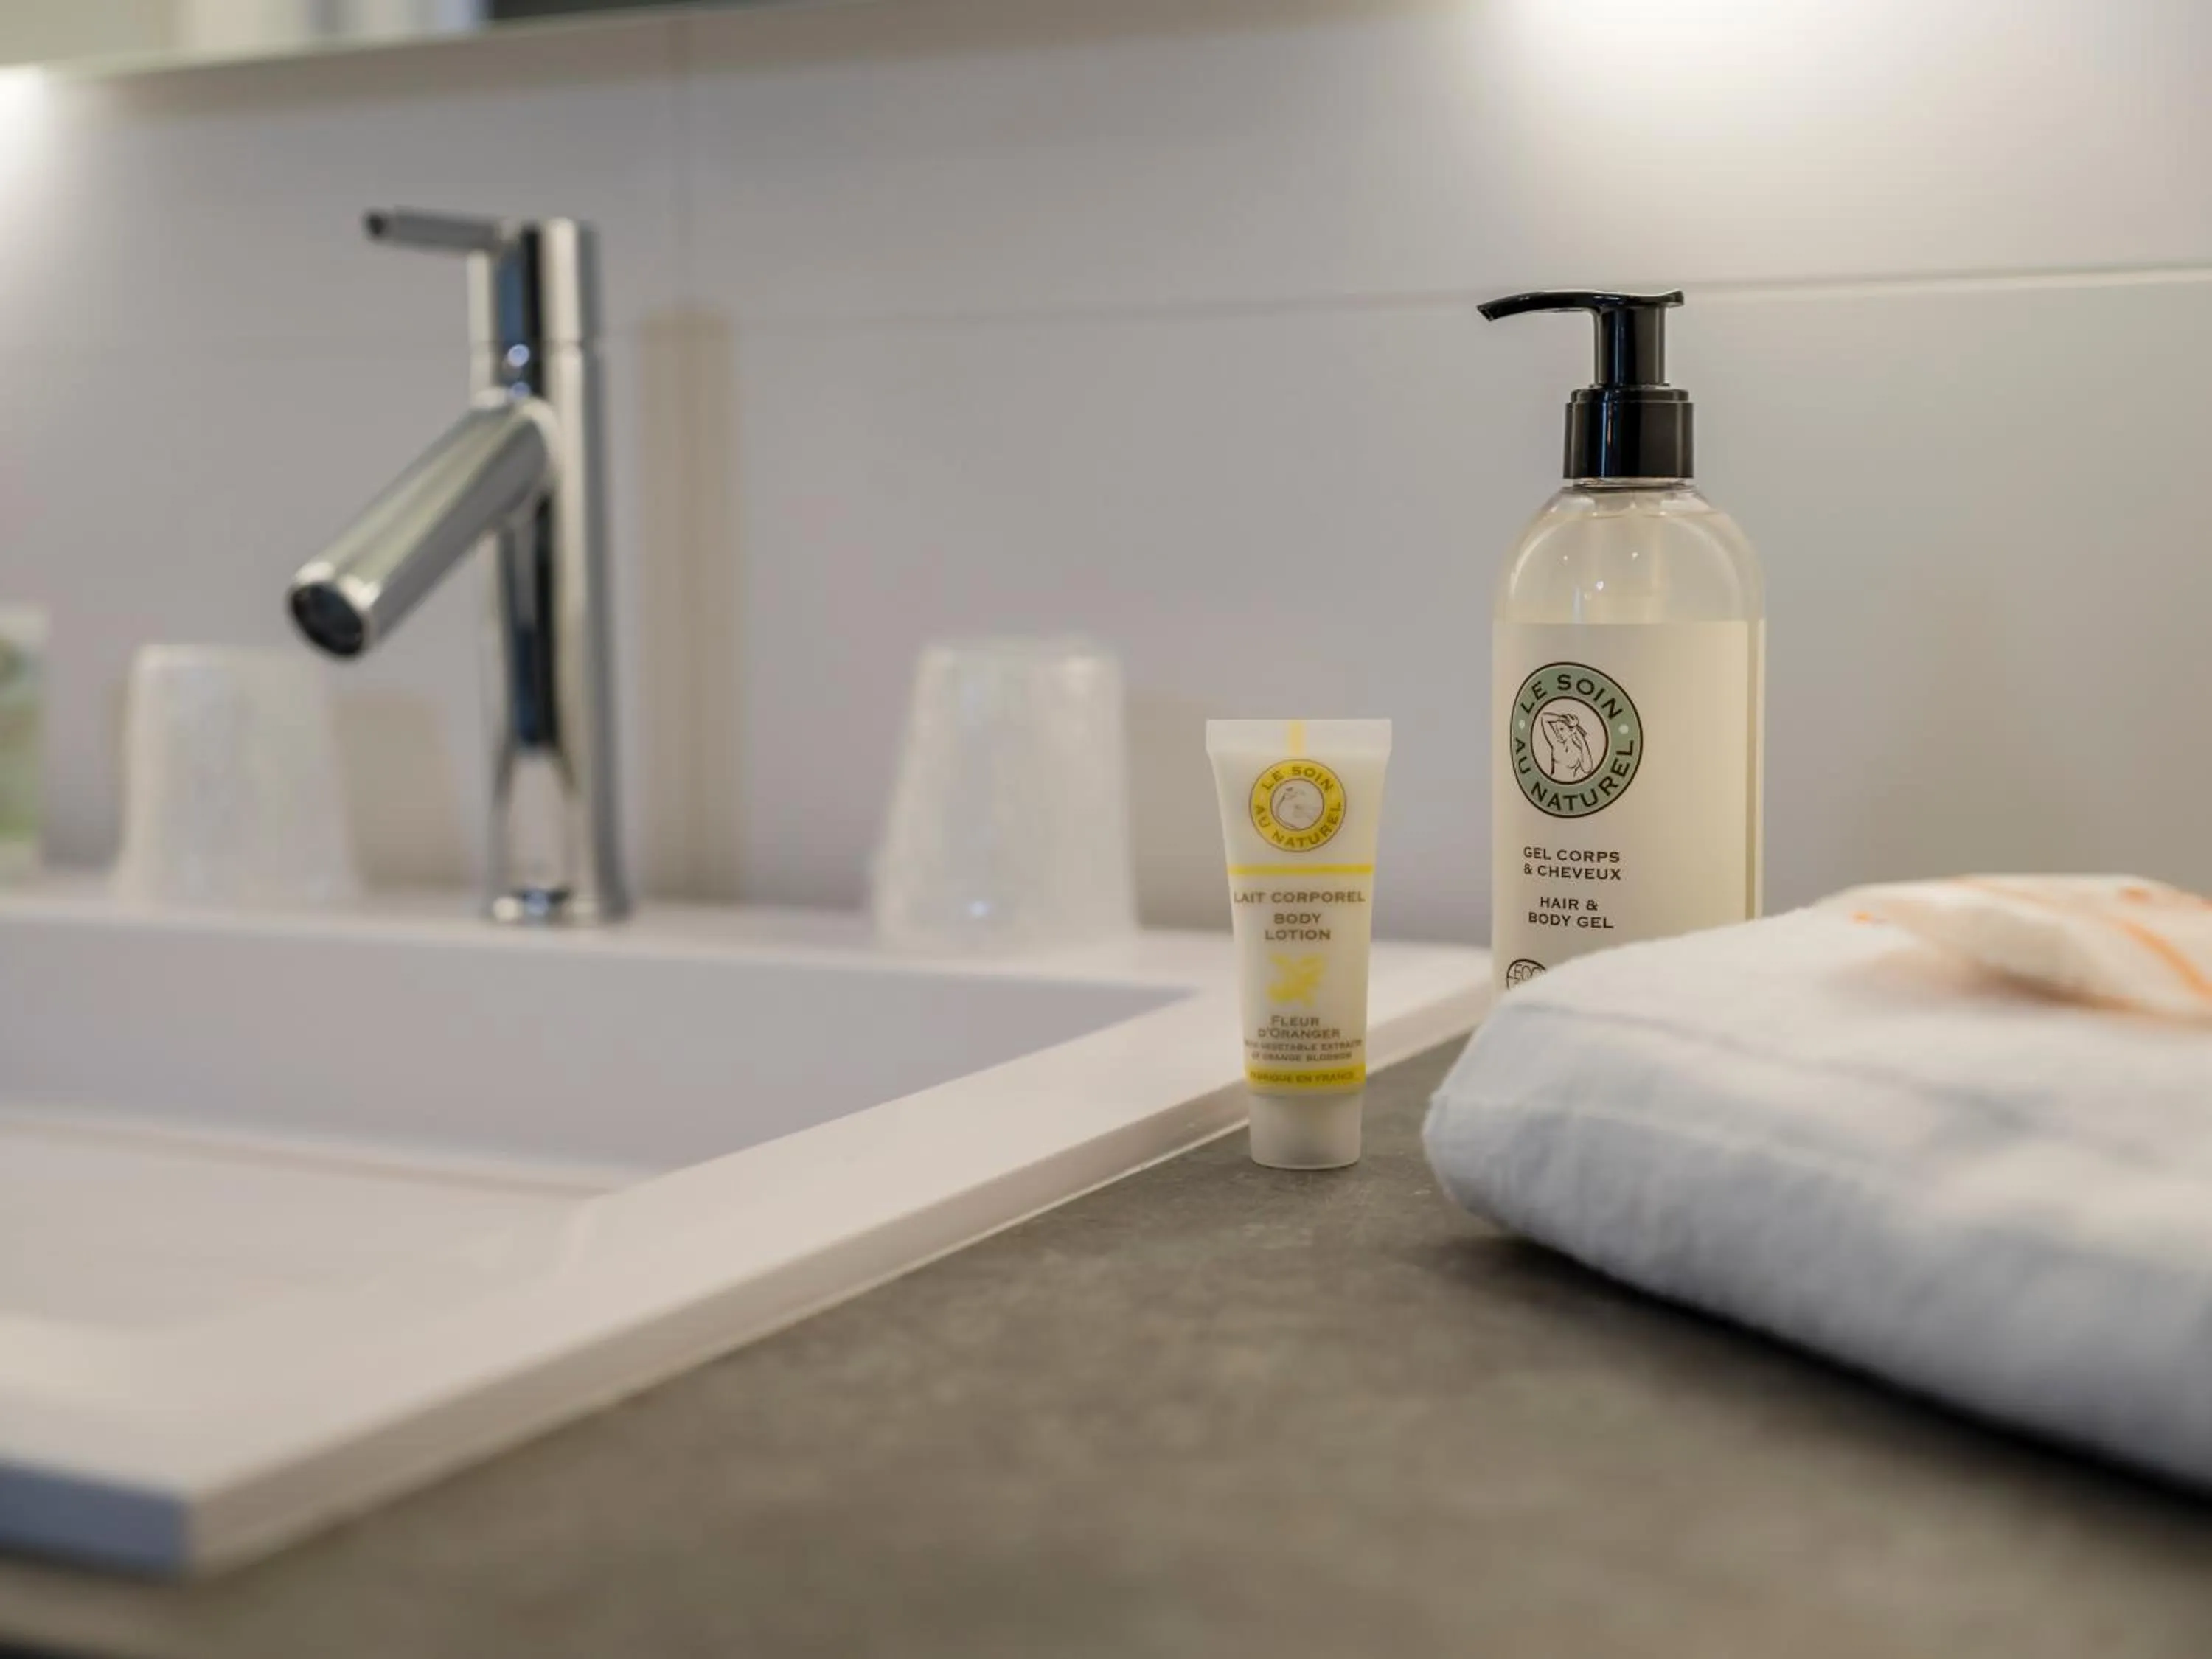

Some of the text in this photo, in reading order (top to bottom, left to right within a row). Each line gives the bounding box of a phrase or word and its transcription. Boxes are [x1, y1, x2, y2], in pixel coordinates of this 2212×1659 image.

[1520, 674, 1623, 720] LE SOIN
[1262, 766, 1335, 792] LE SOIN
[1515, 737, 1635, 810] AU NATUREL
[1255, 801, 1342, 848] AU NATUREL
[1523, 846, 1621, 863] GEL CORPS
[1523, 863, 1621, 880] & CHEVEUX
[1234, 891, 1366, 904] LAIT CORPOREL
[1540, 896, 1598, 911] HAIR &
[1273, 912, 1322, 925] BODY
[1528, 912, 1614, 929] BODY GEL
[1265, 929, 1332, 941] LOTION
[1271, 1015, 1321, 1027] FLEUR
[1258, 1027, 1341, 1040] D'ORANGER
